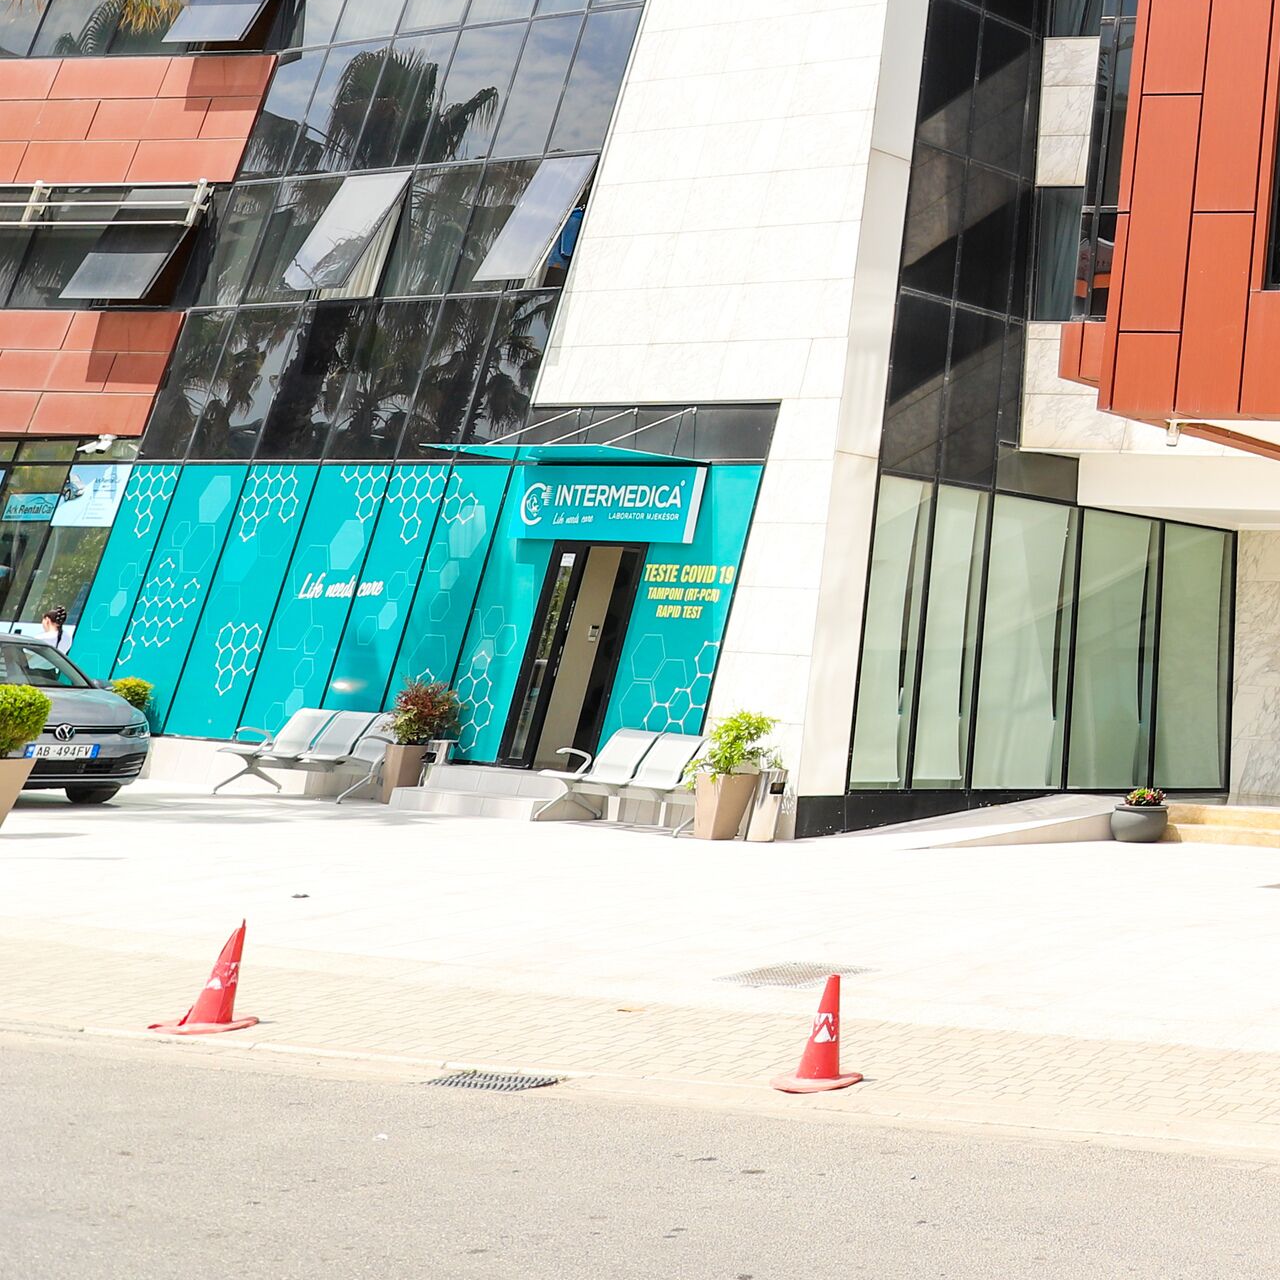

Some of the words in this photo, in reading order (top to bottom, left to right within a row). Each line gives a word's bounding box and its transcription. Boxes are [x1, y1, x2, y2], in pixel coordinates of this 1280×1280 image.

[554, 484, 682, 508] INTERMEDICA
[18, 504, 42, 515] Rental
[42, 504, 55, 514] Car
[608, 512, 645, 520] LABORATOR
[644, 564, 680, 583] TESTE
[680, 565, 717, 584] COVID
[719, 565, 735, 584] 19
[298, 572, 326, 599] Life
[325, 574, 356, 598] needs
[357, 580, 384, 598] care
[647, 586, 684, 601] TAMPONI
[684, 587, 721, 604] (RT-PCR)
[656, 604, 682, 618] RAPID
[682, 605, 703, 619] TEST
[35, 746, 51, 757] AB
